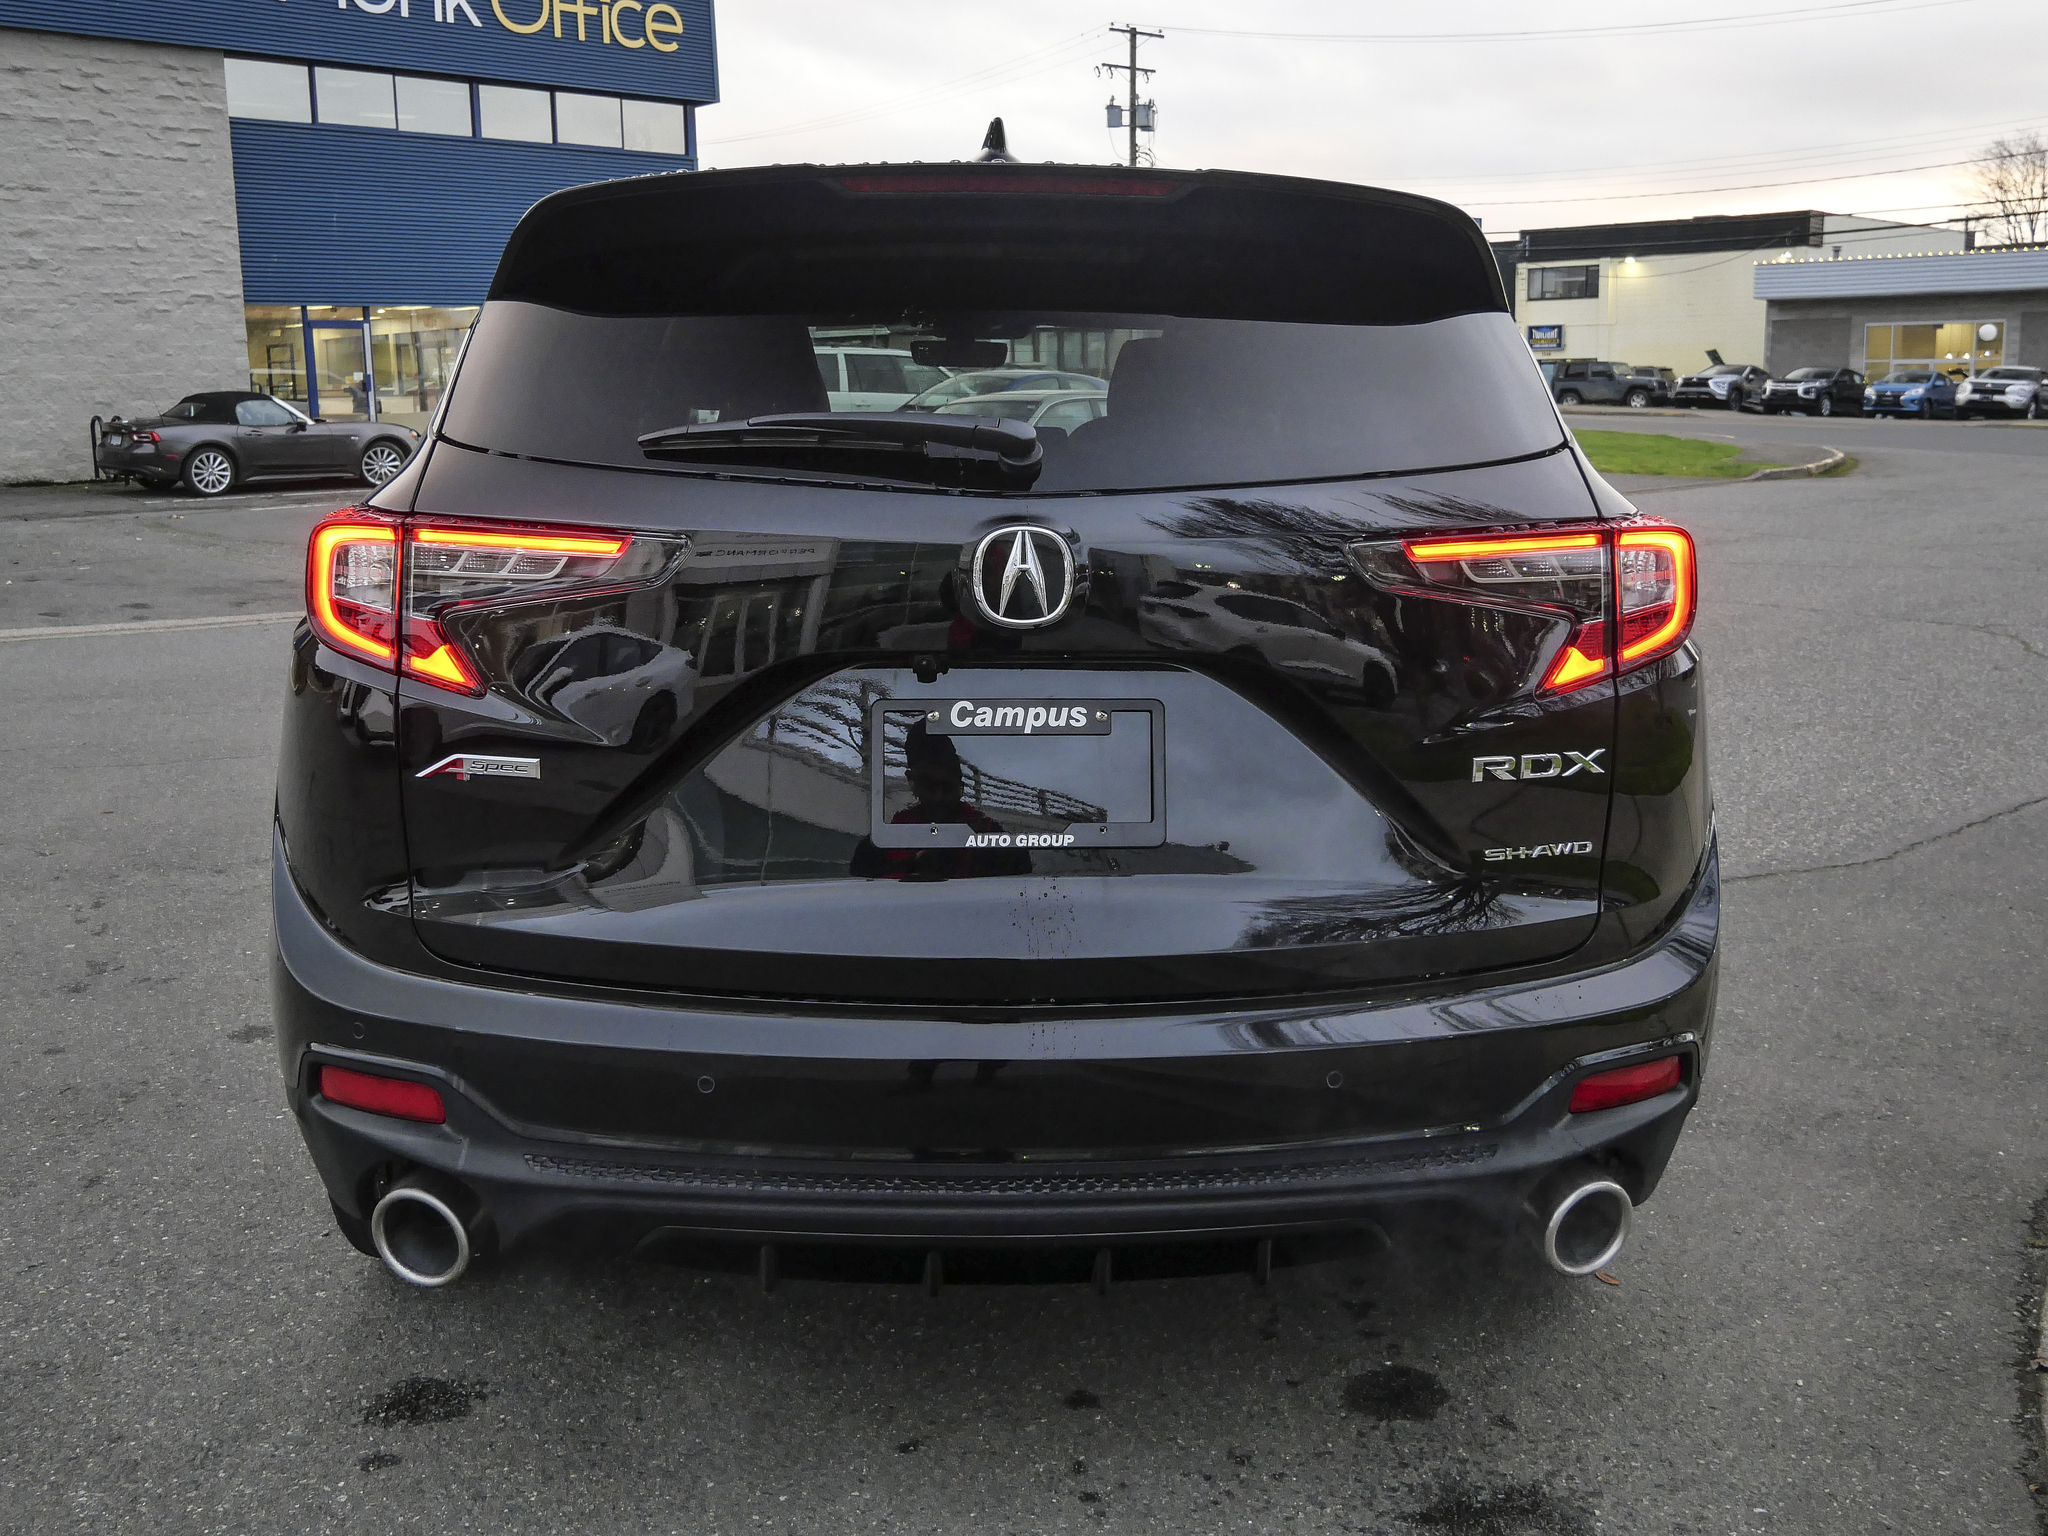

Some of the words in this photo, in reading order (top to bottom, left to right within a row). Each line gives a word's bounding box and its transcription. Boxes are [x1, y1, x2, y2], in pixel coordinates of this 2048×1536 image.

[492, 0, 684, 53] Office
[950, 701, 1087, 734] Campus
[1472, 748, 1606, 783] RDX
[965, 835, 1010, 847] AUTO
[1015, 834, 1075, 847] GROUP
